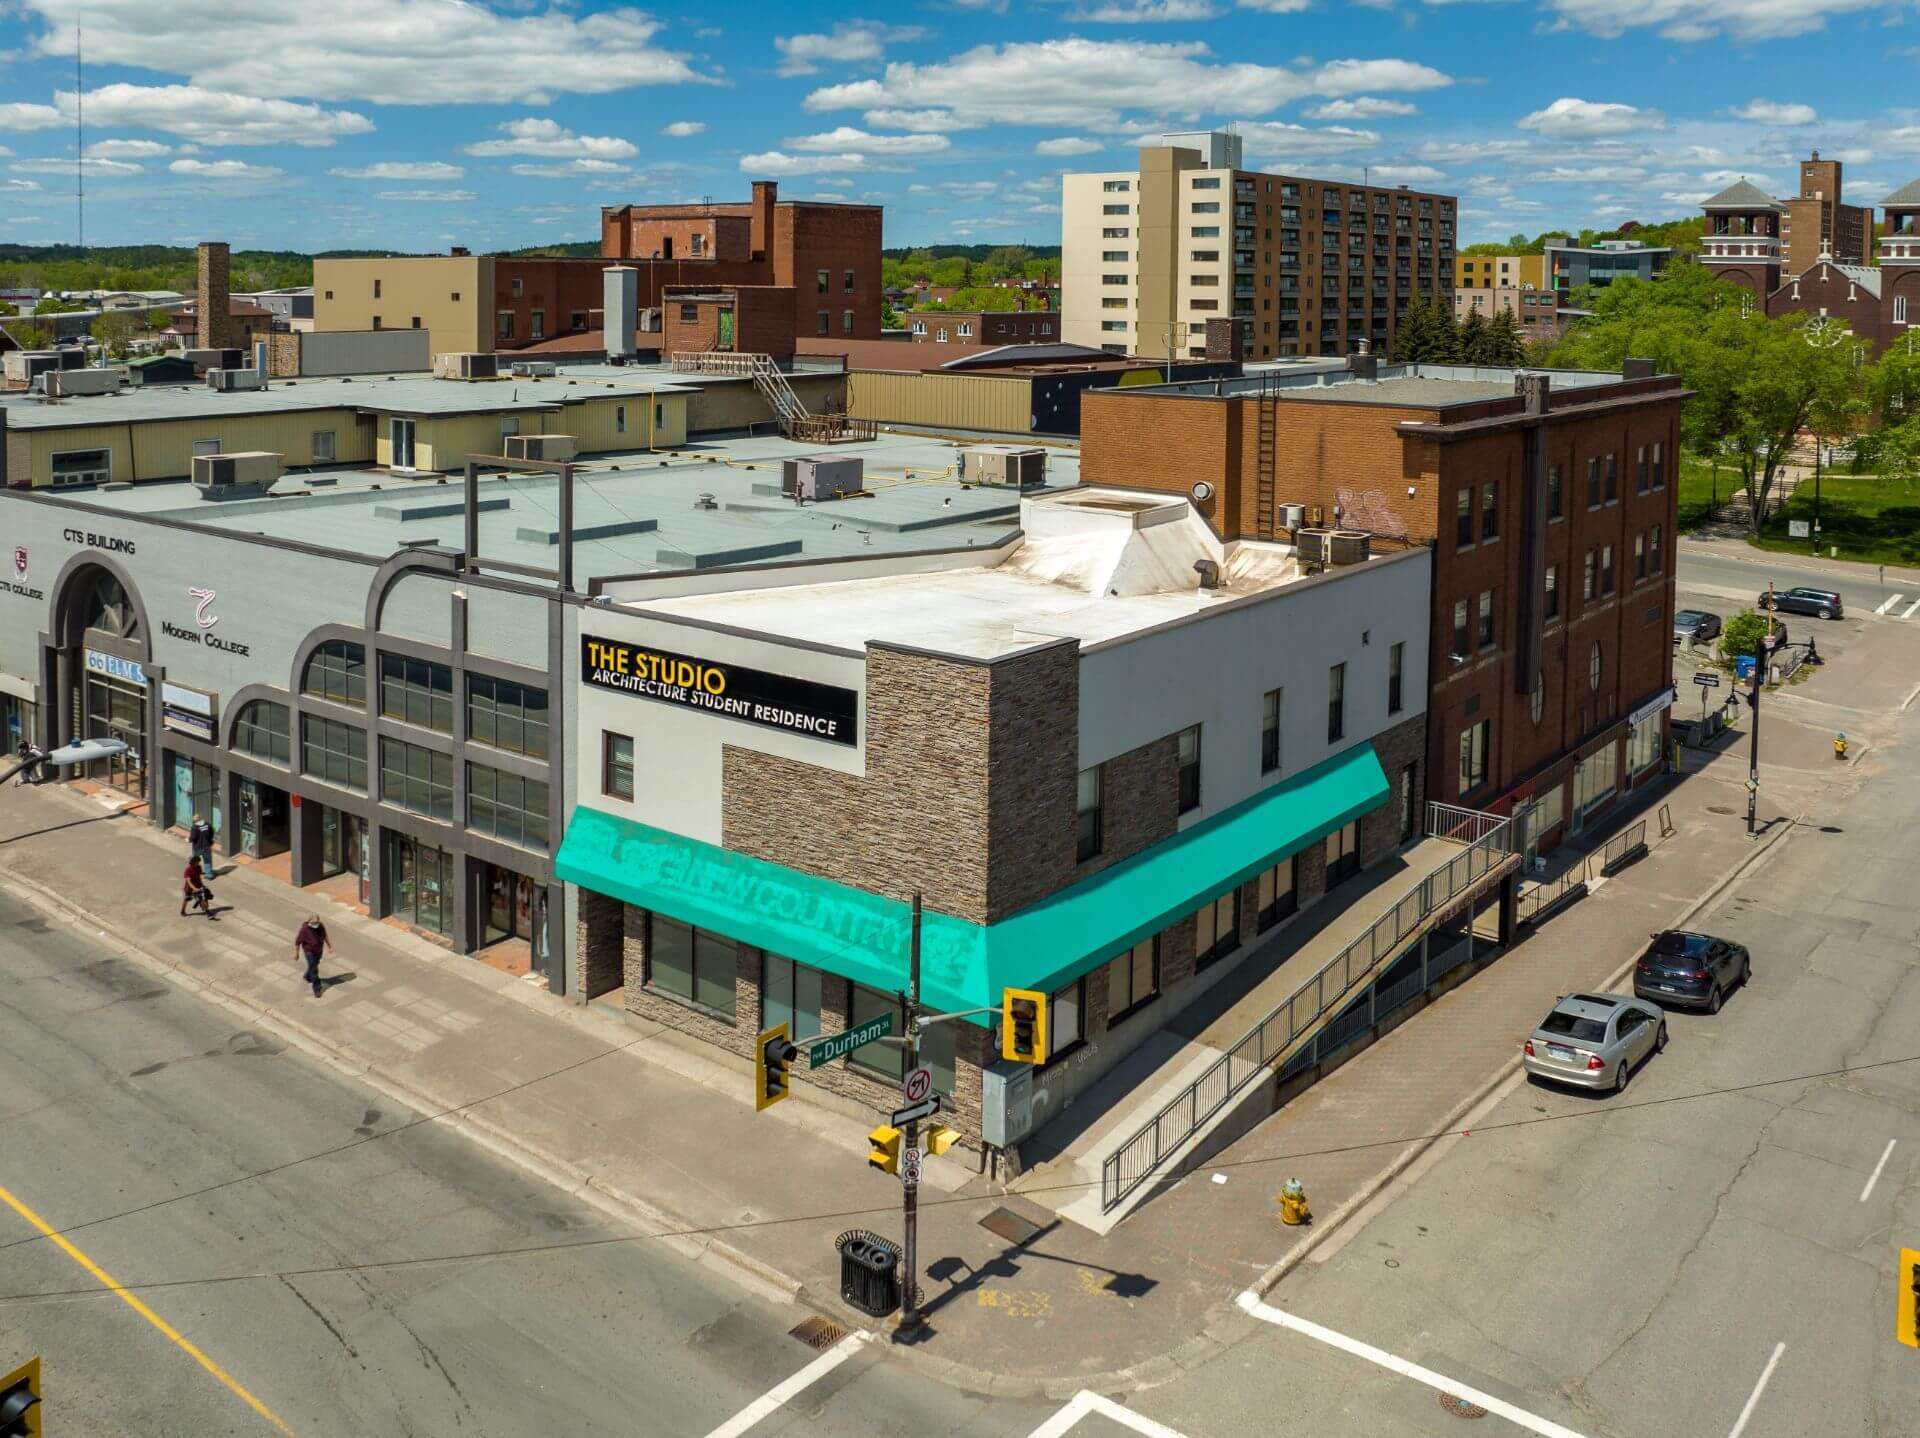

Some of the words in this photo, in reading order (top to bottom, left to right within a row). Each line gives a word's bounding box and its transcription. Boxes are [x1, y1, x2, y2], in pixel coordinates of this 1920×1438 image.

[63, 528, 84, 544] CTS
[87, 531, 136, 555] BUILDING
[12, 585, 44, 600] COLLEGE
[88, 651, 104, 670] 66
[108, 656, 132, 680] ELM
[588, 642, 629, 674] THE
[634, 653, 727, 695] STUDIO
[592, 668, 687, 702] ARCHITECTURE
[690, 689, 752, 716] STUDENT
[754, 704, 837, 736] RESIDENCE
[824, 1023, 881, 1060] Durham
